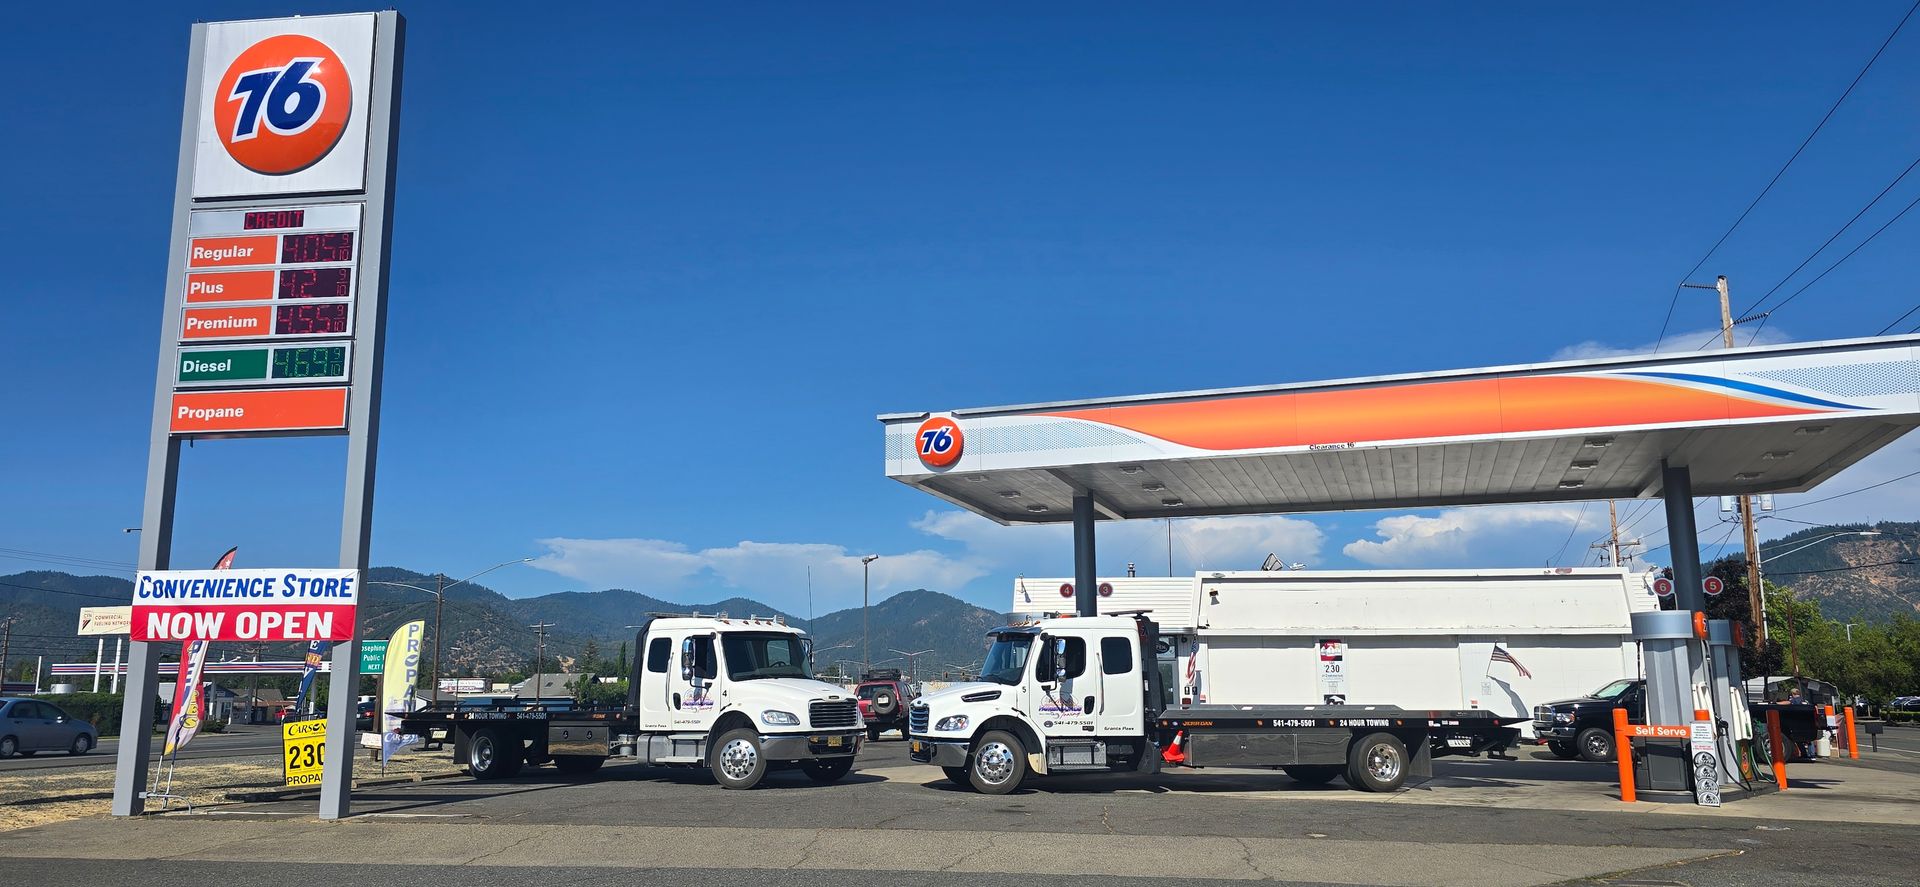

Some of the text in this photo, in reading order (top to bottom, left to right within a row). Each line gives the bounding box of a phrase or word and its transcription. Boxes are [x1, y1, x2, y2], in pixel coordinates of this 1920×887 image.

[227, 57, 326, 143] 76
[245, 210, 304, 229] CREDIT
[193, 245, 254, 261] Regular
[190, 281, 224, 294] Plus
[186, 316, 258, 330] Premium
[182, 359, 232, 373] Diesel
[178, 406, 244, 421] Propane
[921, 425, 953, 455] 76
[1309, 443, 1345, 451] Clearance
[138, 573, 354, 598] CONVENIENCE STORE
[1660, 583, 1667, 591] 6
[1709, 581, 1717, 590] 5
[147, 610, 333, 639] NOW OPEN
[361, 644, 385, 653] osephine
[403, 624, 420, 712] PROPAN
[468, 712, 507, 720] 24 HOUR TOWING
[516, 712, 547, 720] 541-479-5501
[1273, 719, 1315, 727] 541-479-5501
[1339, 719, 1389, 727] 24 HOUR TOWING
[1635, 726, 1655, 735] Self
[1657, 727, 1687, 736] Serve
[286, 773, 323, 786] PROPA
